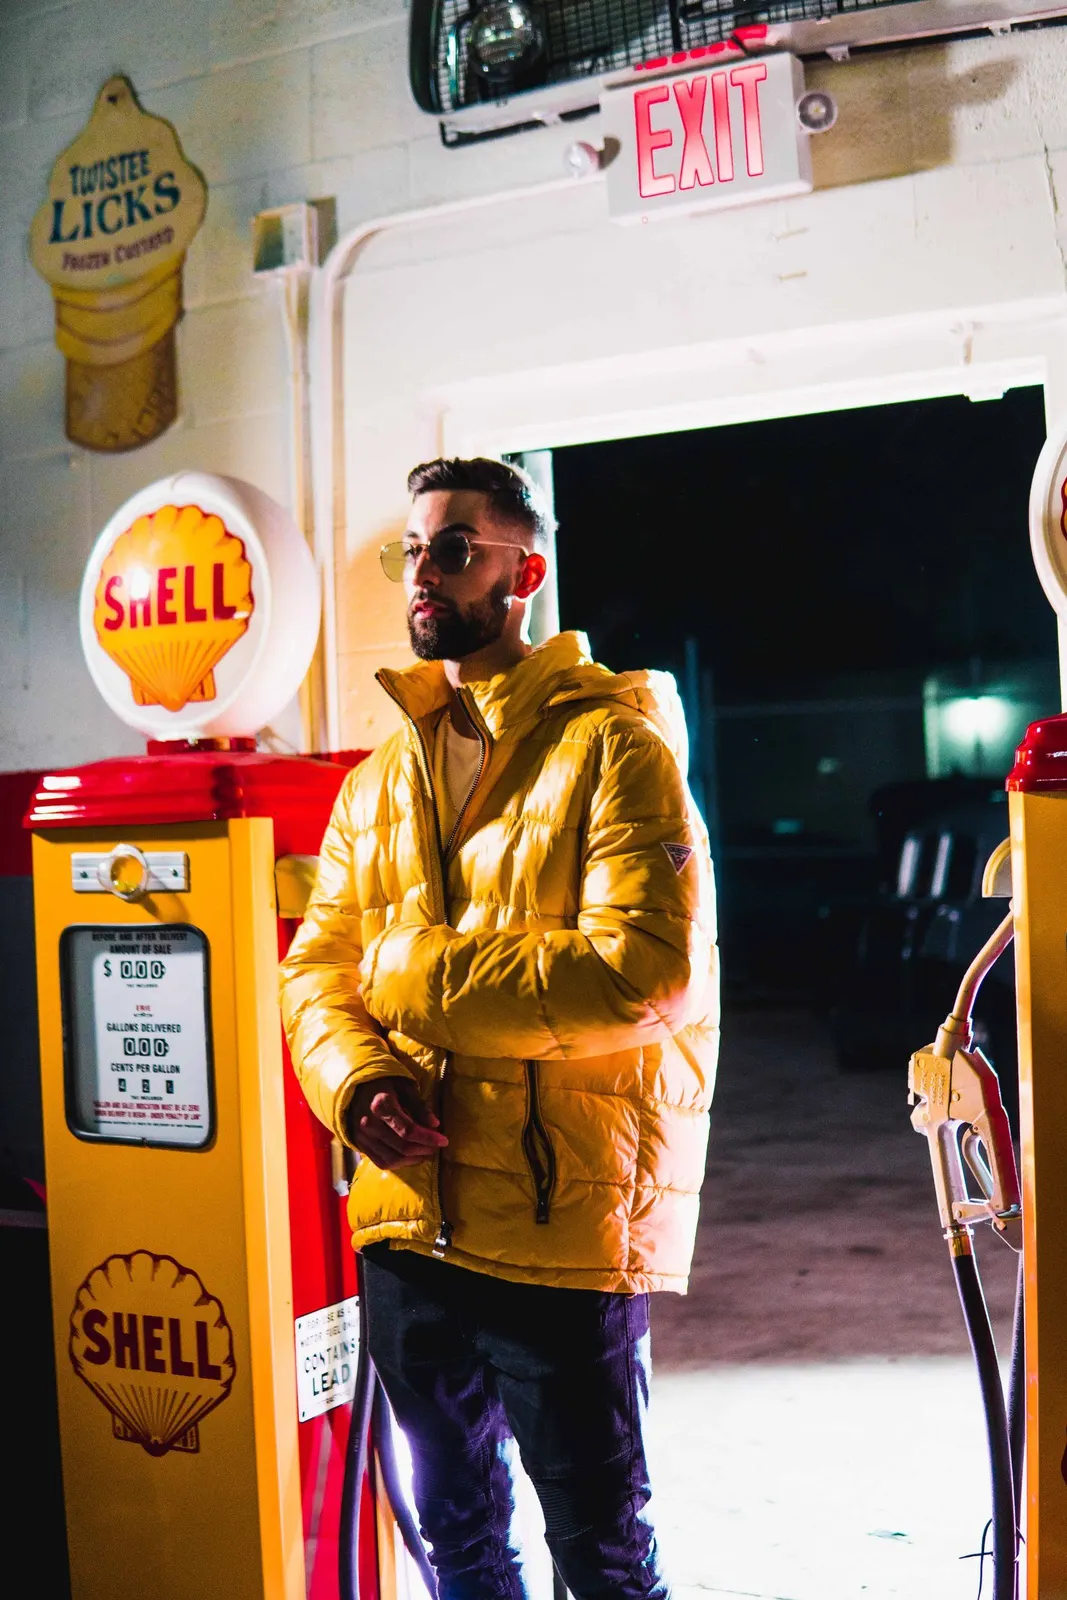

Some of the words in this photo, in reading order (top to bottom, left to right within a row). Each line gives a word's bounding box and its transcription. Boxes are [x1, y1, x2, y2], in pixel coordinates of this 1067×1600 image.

[633, 62, 768, 199] EXIT
[69, 149, 151, 196] TWISTEE
[48, 170, 181, 244] LICKS
[103, 562, 240, 631] SHELL
[103, 959, 112, 977] $
[109, 944, 140, 955] AMOUNT
[142, 944, 151, 955] OF
[153, 944, 172, 955] SALE
[106, 1022, 139, 1033] GALLONS
[141, 1023, 182, 1034] DELIVERED
[110, 1062, 134, 1073] CENTS
[136, 1063, 150, 1074] PER
[152, 1064, 181, 1074] GALLON
[82, 1308, 222, 1381] SHELL
[303, 1337, 356, 1374] CONTAINS
[312, 1362, 351, 1397] LEAD
